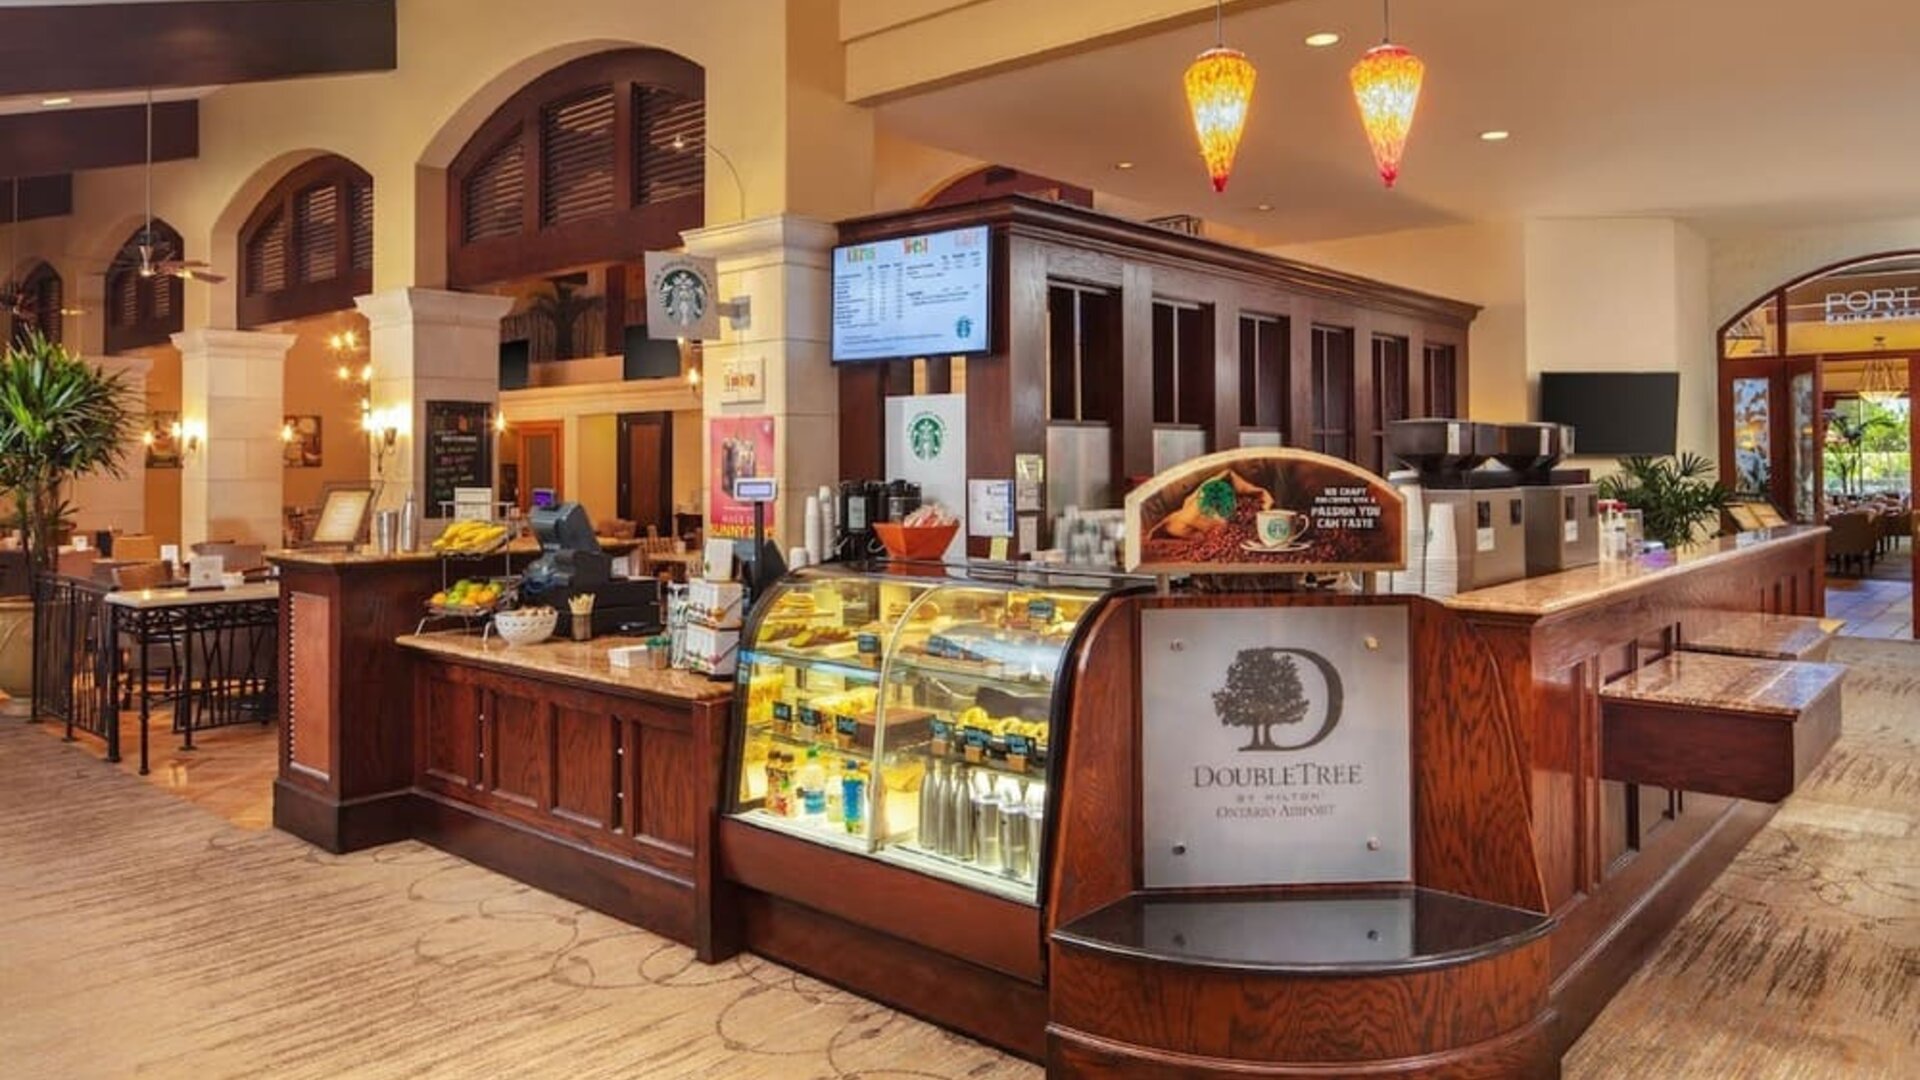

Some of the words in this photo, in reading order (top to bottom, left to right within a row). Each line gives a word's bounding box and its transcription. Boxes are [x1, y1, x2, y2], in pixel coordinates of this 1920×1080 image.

[1358, 506, 1381, 517] YOU
[1317, 518, 1339, 528] CAN
[1341, 518, 1374, 528] TASTE
[1265, 791, 1320, 801] HILTON
